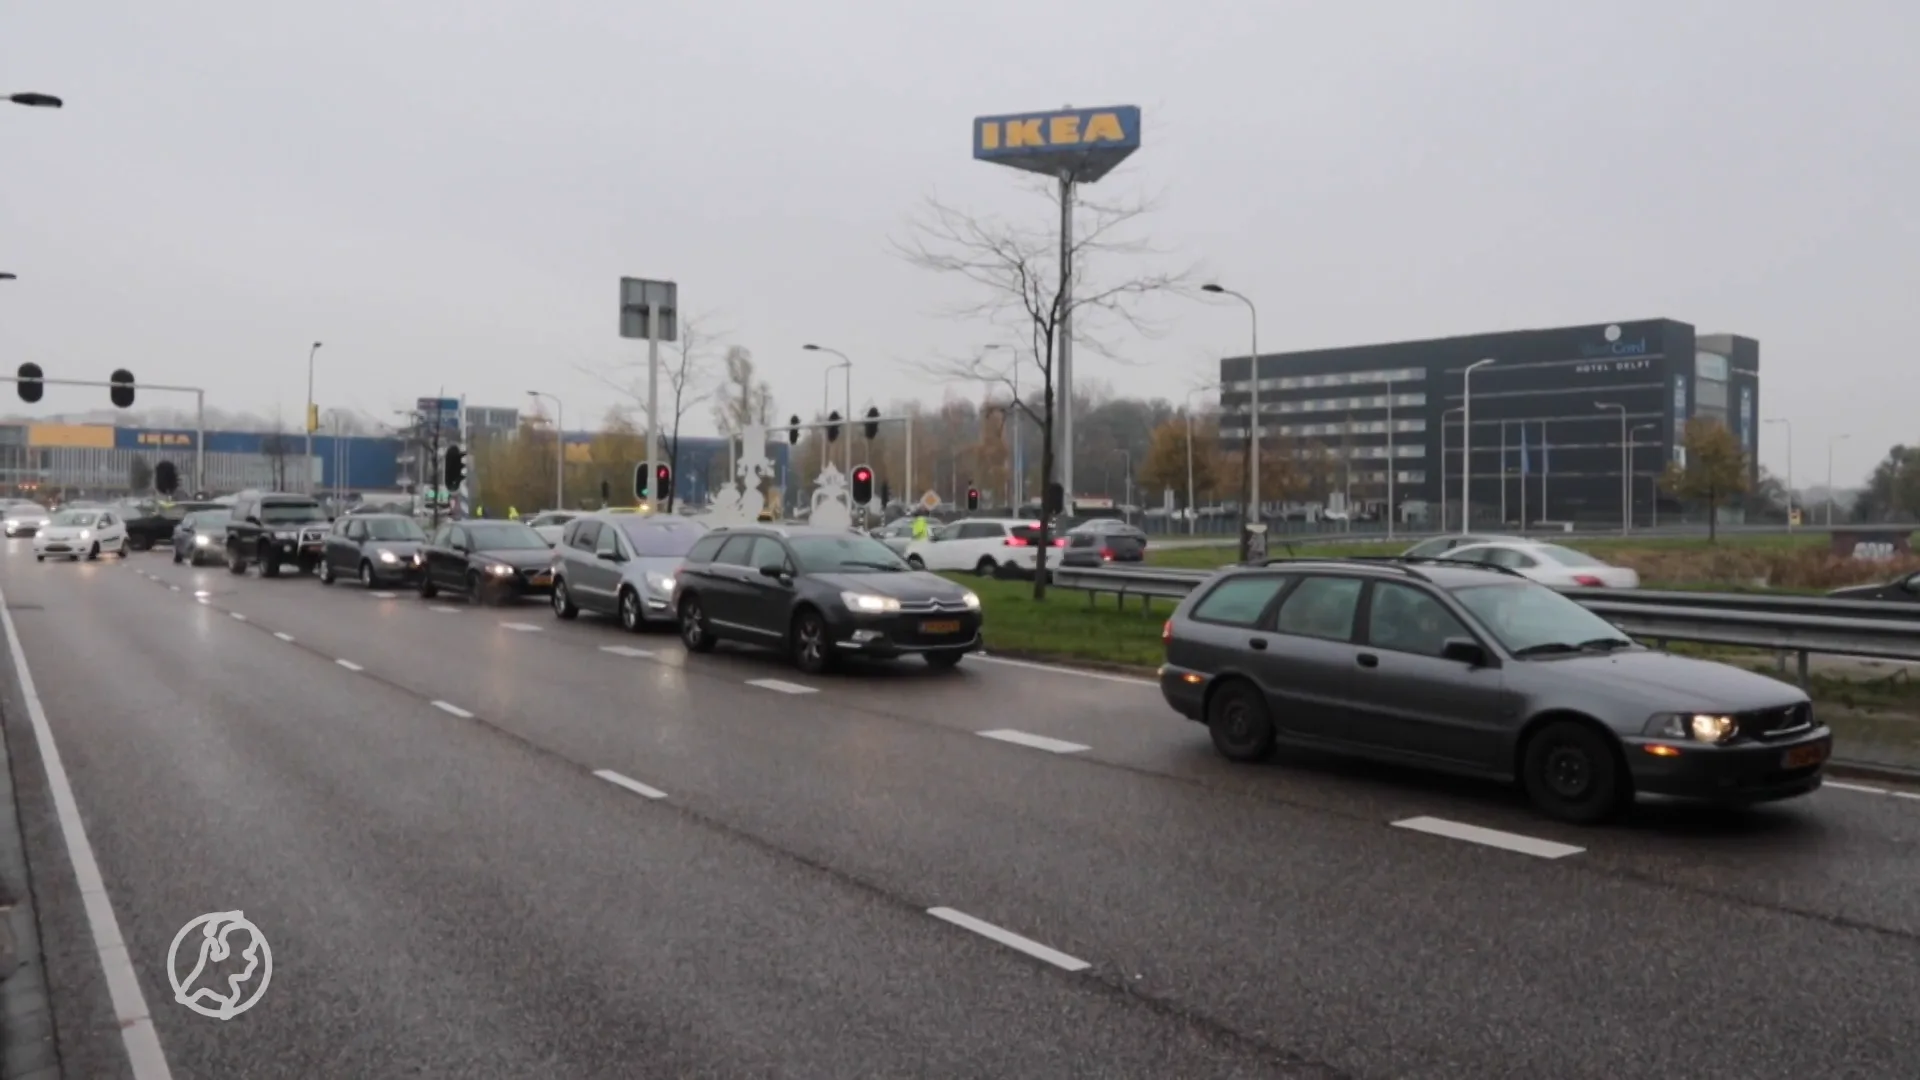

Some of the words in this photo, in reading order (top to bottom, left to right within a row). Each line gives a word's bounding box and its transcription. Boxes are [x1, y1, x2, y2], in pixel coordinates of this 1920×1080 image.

[981, 112, 1125, 150] IKEA
[1575, 364, 1609, 373] HOTEL
[1616, 360, 1650, 371] DELFT
[137, 432, 191, 445] IKEA
